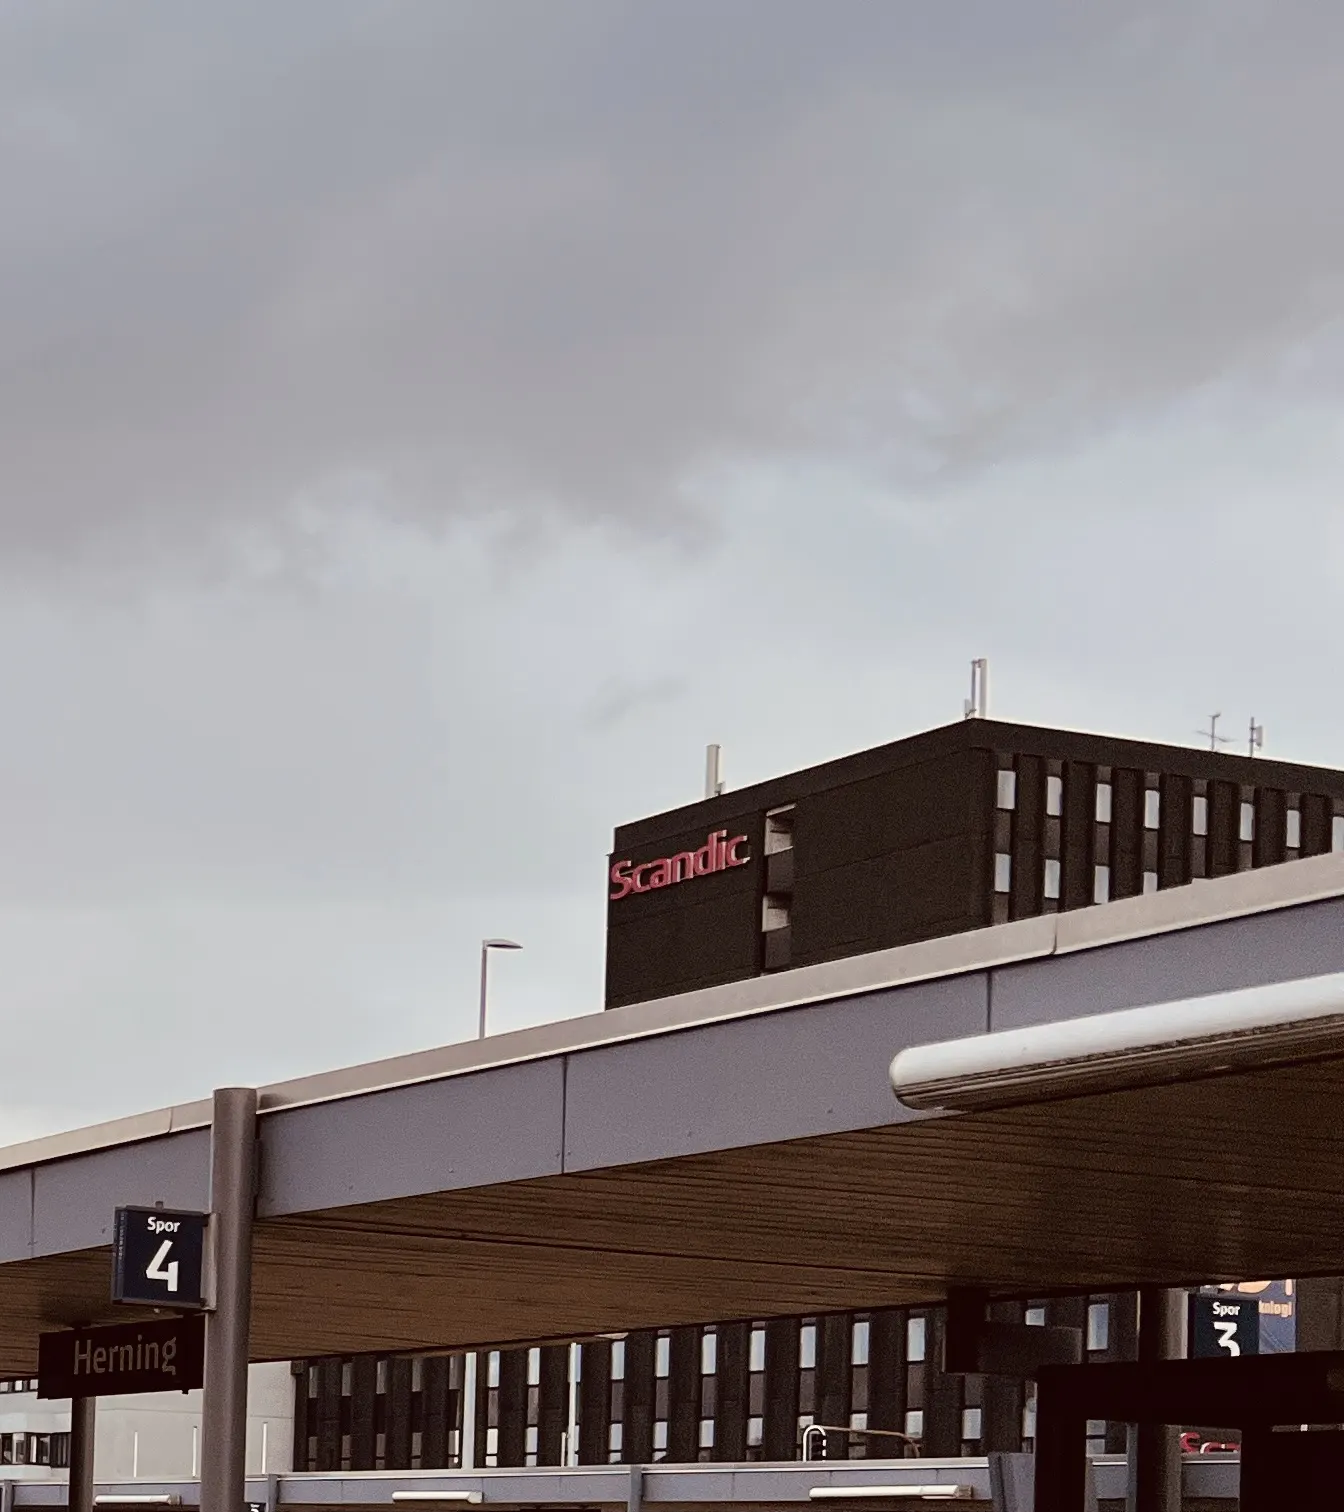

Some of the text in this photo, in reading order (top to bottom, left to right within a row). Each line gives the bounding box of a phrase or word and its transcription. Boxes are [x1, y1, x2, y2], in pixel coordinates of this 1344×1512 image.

[609, 829, 751, 900] Scandic
[147, 1217, 181, 1234] Spor
[146, 1239, 179, 1292] 4
[1212, 1302, 1241, 1317] Spor
[73, 1334, 177, 1376] Herning
[1213, 1321, 1241, 1357] 3
